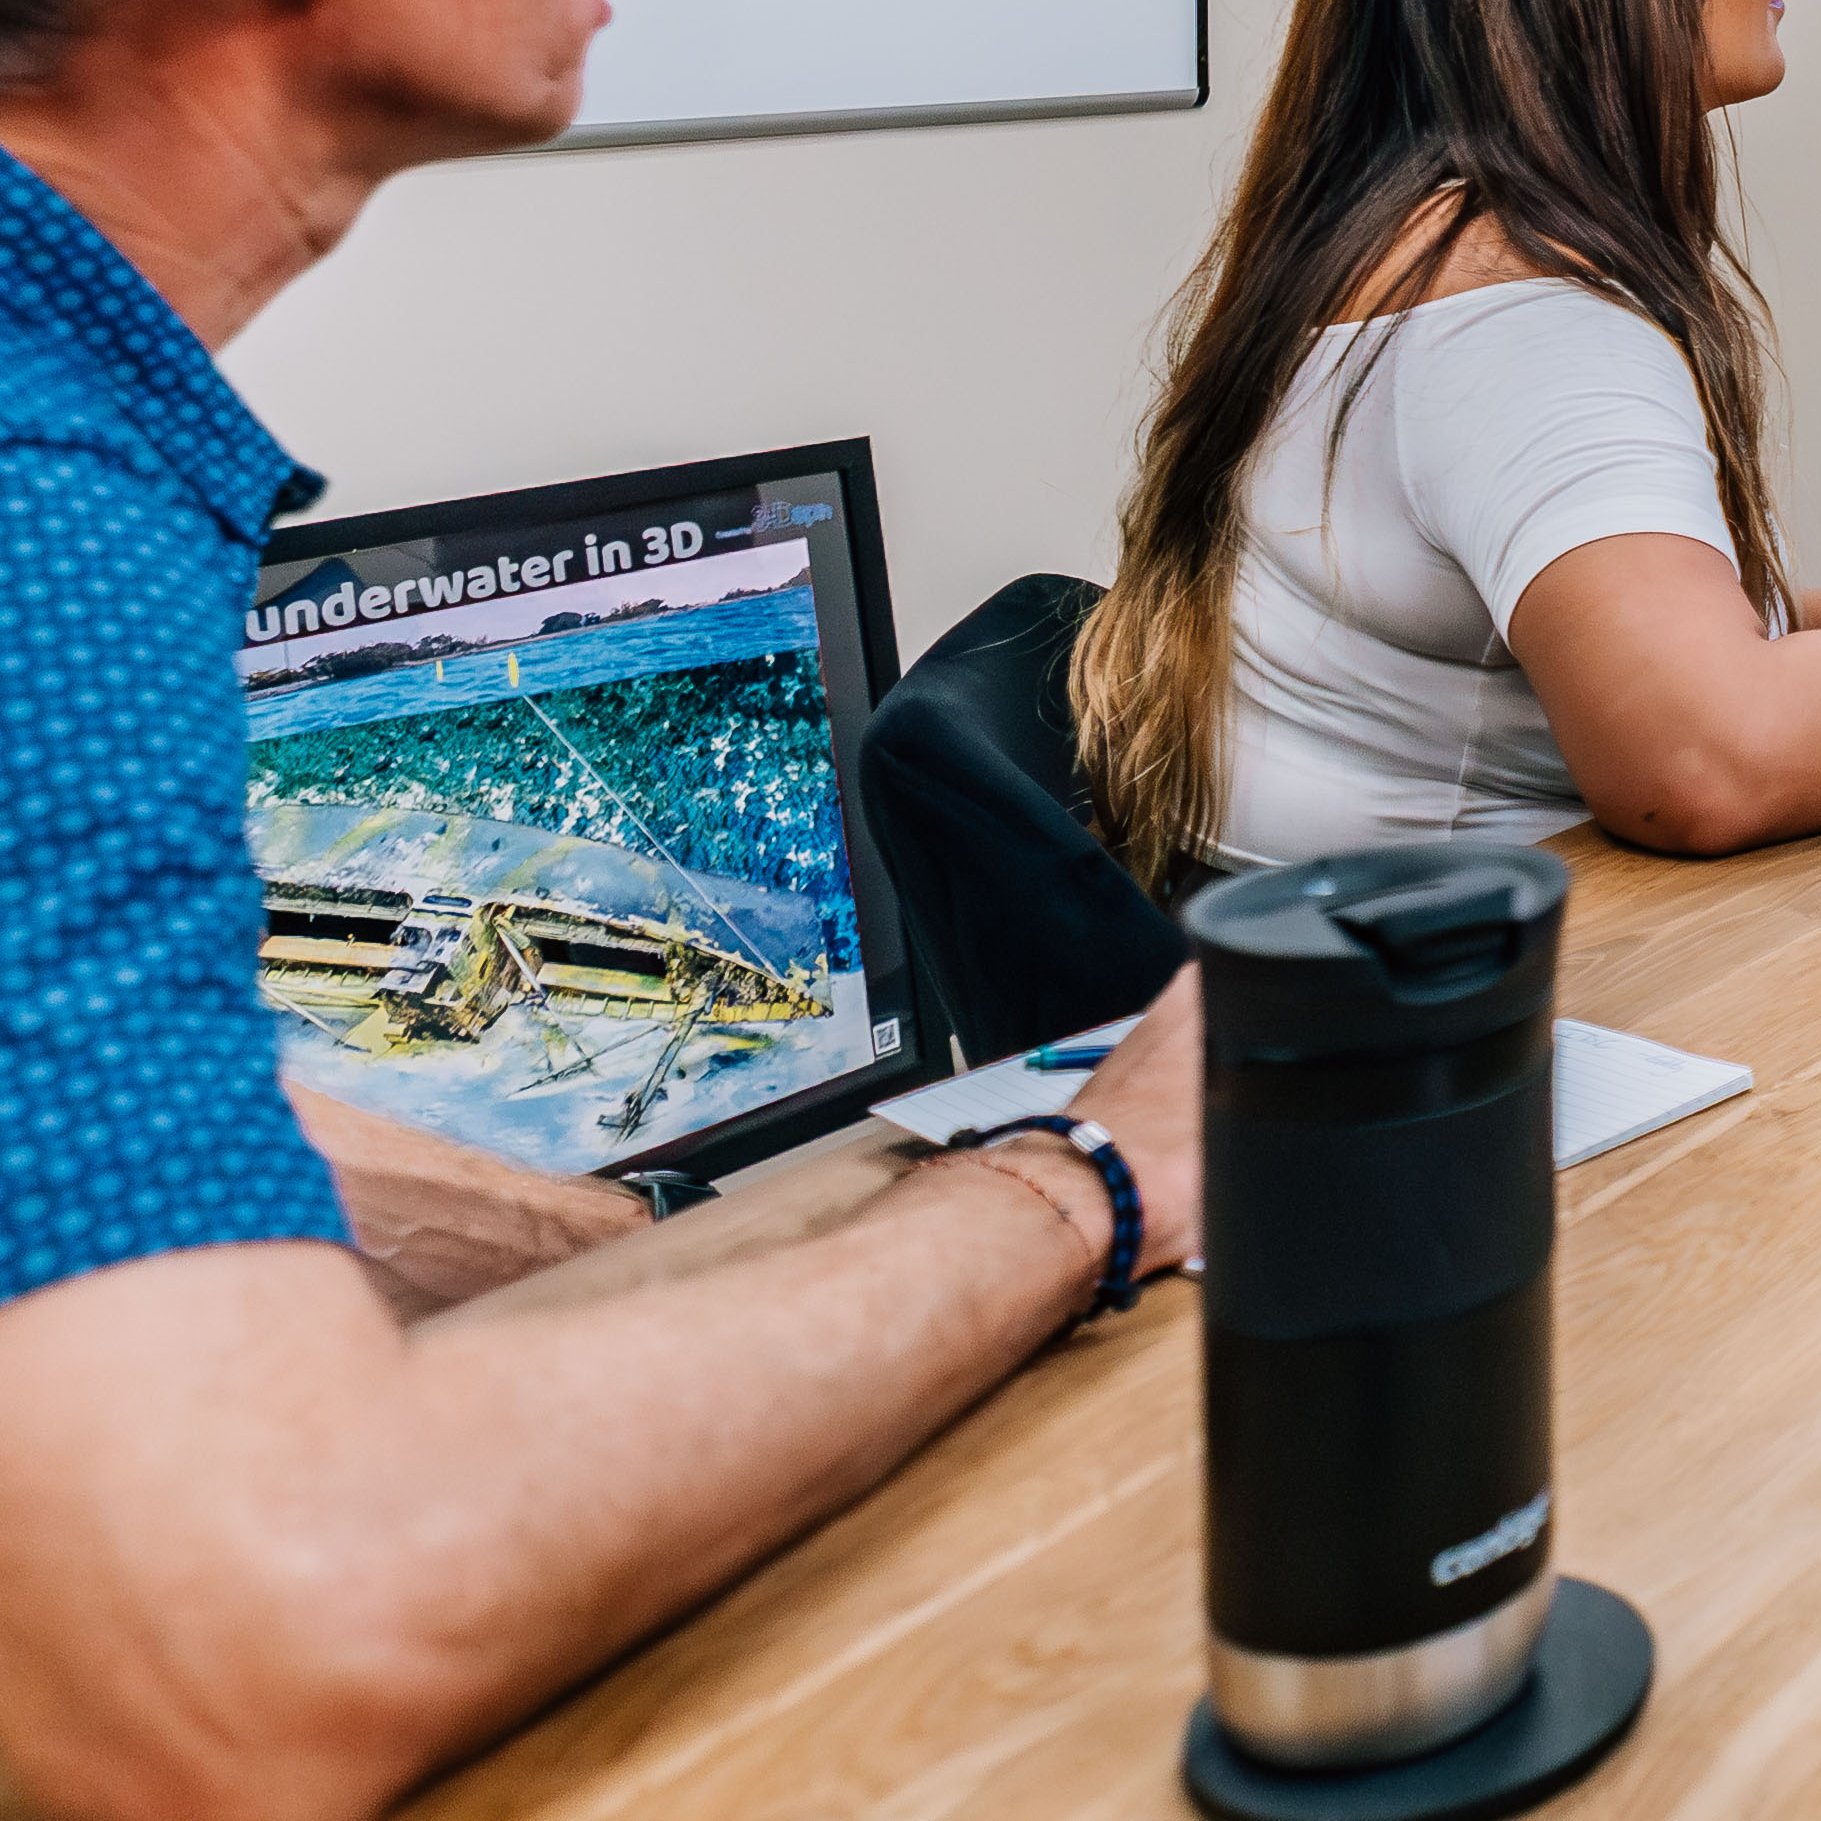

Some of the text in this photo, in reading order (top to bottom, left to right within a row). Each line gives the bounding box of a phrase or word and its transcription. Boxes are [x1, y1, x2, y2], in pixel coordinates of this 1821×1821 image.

[246, 521, 703, 643] underwater in 3D
